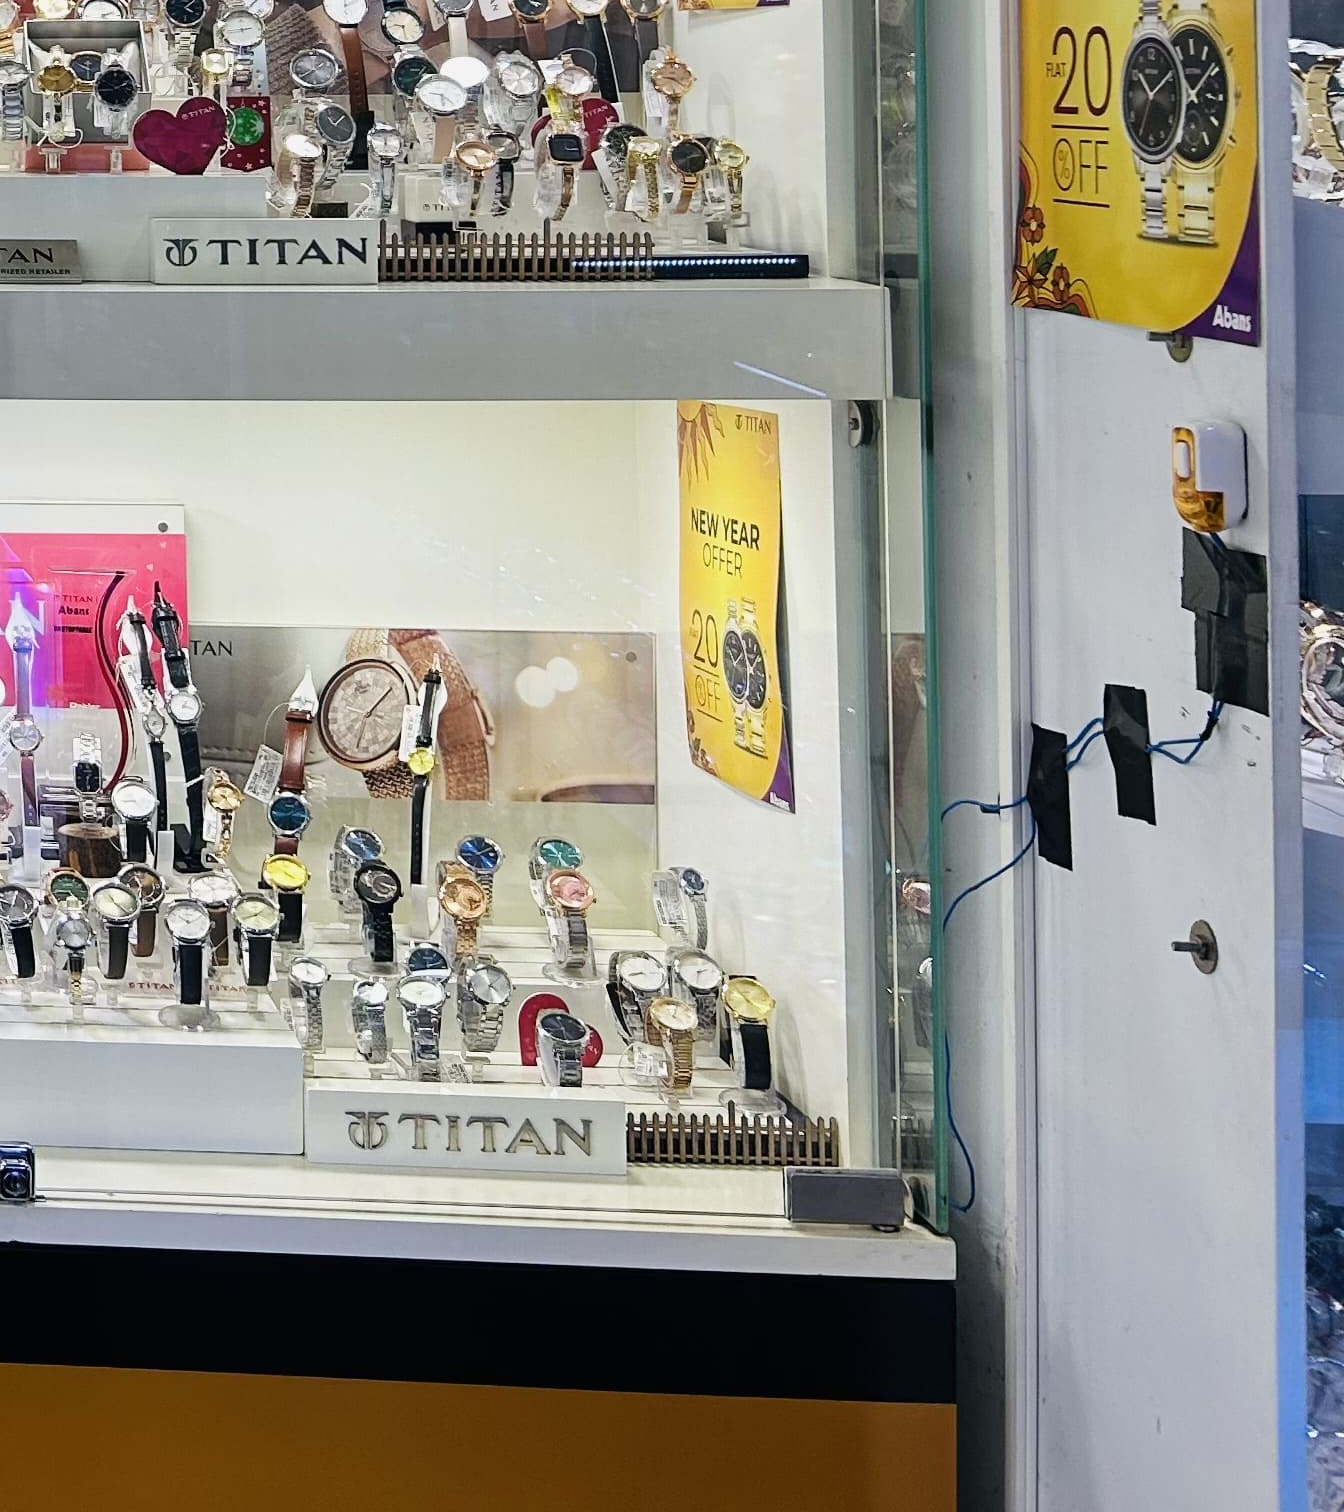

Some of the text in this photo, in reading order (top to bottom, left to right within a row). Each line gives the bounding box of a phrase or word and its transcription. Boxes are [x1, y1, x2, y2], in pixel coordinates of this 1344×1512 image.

[1045, 61, 1067, 80] FLAT
[1052, 25, 1112, 116] 20
[1053, 137, 1110, 191] OFF
[206, 237, 369, 268] TITAN
[1212, 303, 1252, 333] Abans
[744, 414, 772, 435] TITAN
[691, 506, 760, 552] NEW YEAR
[702, 542, 743, 578] OFFER
[191, 640, 233, 658] TAN
[692, 607, 718, 669] 20
[398, 1112, 593, 1157] TITAN
